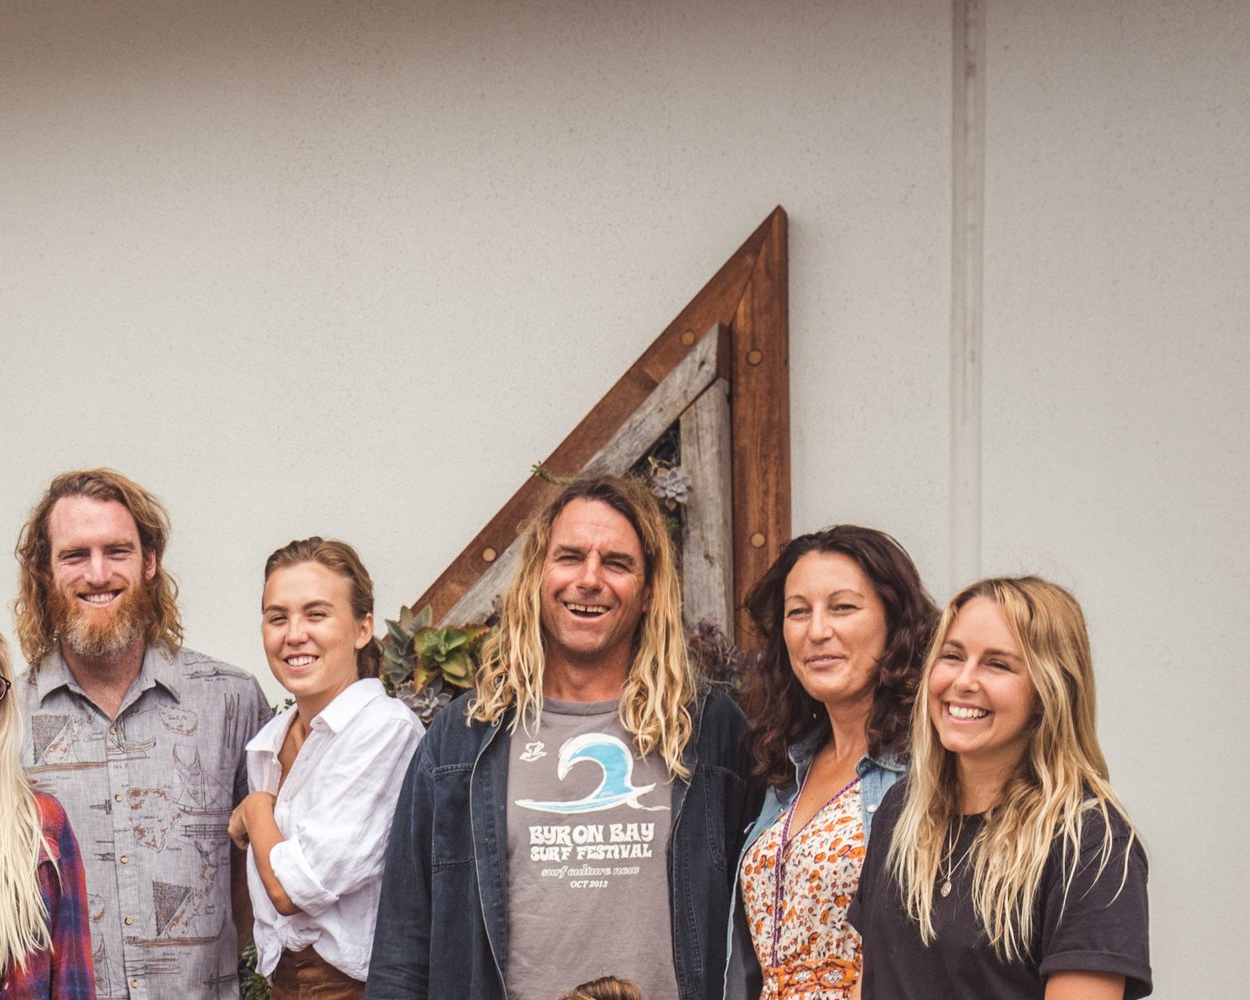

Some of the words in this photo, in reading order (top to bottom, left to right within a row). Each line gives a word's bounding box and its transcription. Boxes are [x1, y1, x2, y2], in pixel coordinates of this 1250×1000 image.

[529, 825, 604, 846] BYRON
[609, 823, 654, 842] BAY
[530, 846, 572, 862] SURF
[576, 844, 652, 860] FESTIVAL
[541, 865, 568, 879] surf
[568, 864, 611, 876] culture
[613, 866, 640, 876] now
[570, 880, 588, 888] OCT
[589, 880, 608, 888] 2013
